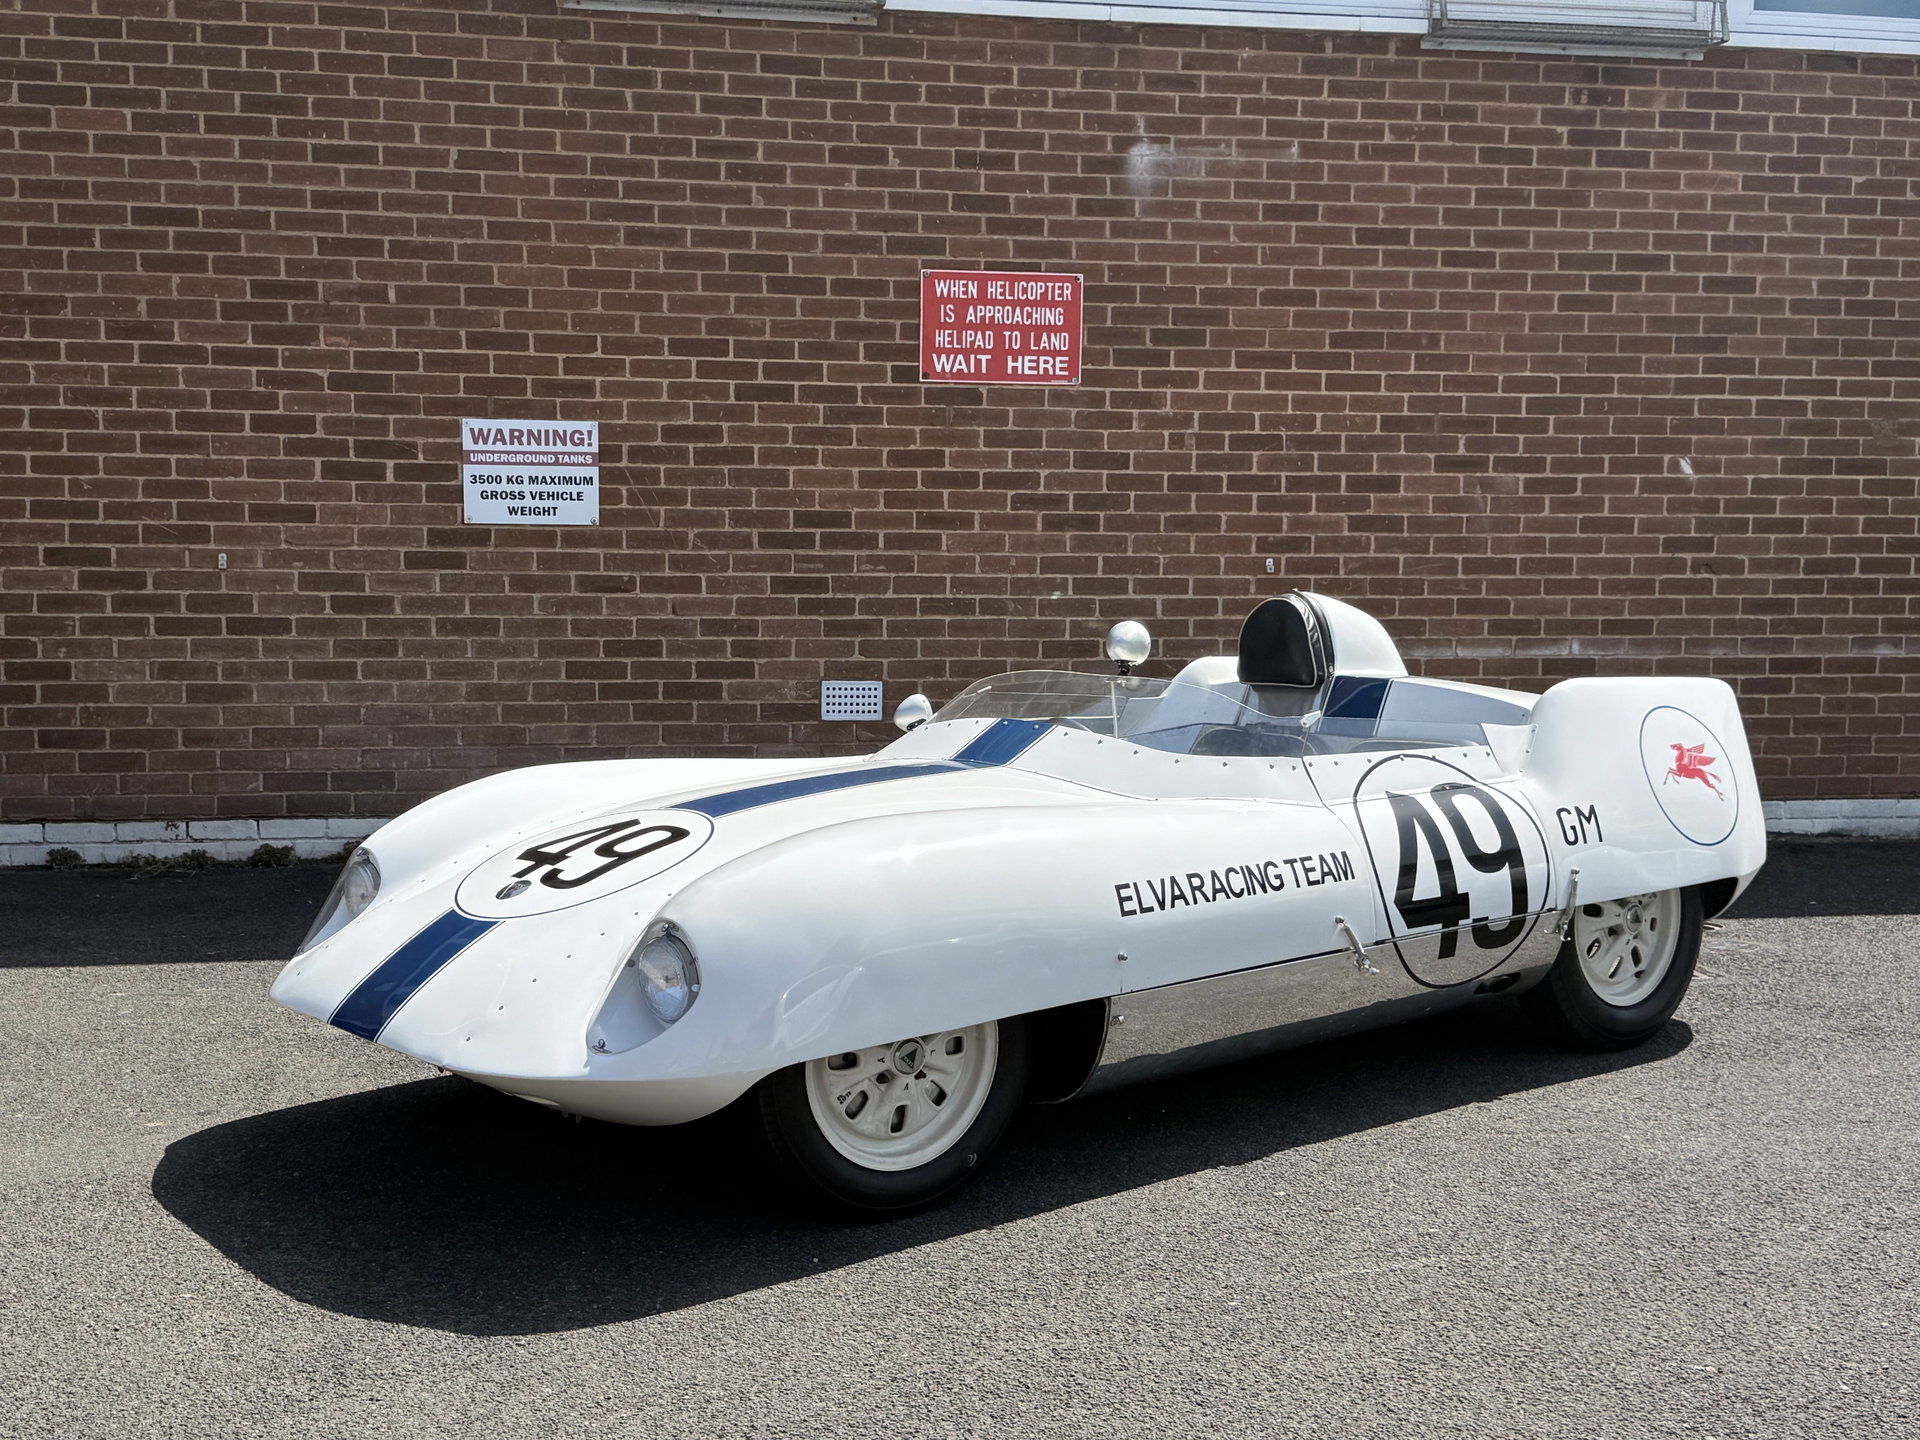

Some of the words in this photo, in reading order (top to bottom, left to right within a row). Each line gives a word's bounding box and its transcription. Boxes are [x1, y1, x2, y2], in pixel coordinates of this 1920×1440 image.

[934, 279, 978, 299] WHEN
[987, 281, 1072, 301] HELICOPTER
[940, 304, 955, 323] IS
[966, 305, 1064, 326] APPROACHING
[935, 329, 994, 349] HELIPAD
[1003, 331, 1021, 350] TO
[1030, 332, 1069, 351] LAND
[932, 353, 991, 374] WAIT
[1007, 355, 1069, 376] HERE
[469, 427, 593, 447] WARNING!
[470, 453, 555, 463] UNDERGROUND
[557, 454, 593, 464] TANKS
[470, 474, 503, 485] 3500
[506, 475, 524, 485] KG
[528, 475, 594, 486] MAXIMUM
[480, 490, 526, 501] GROSS
[529, 491, 584, 501] VEHICLE
[507, 506, 558, 516] WEIGHT
[1556, 804, 1603, 846] GM
[511, 818, 691, 890] 49
[1282, 850, 1356, 889] TEAM
[1385, 782, 1529, 960] 49
